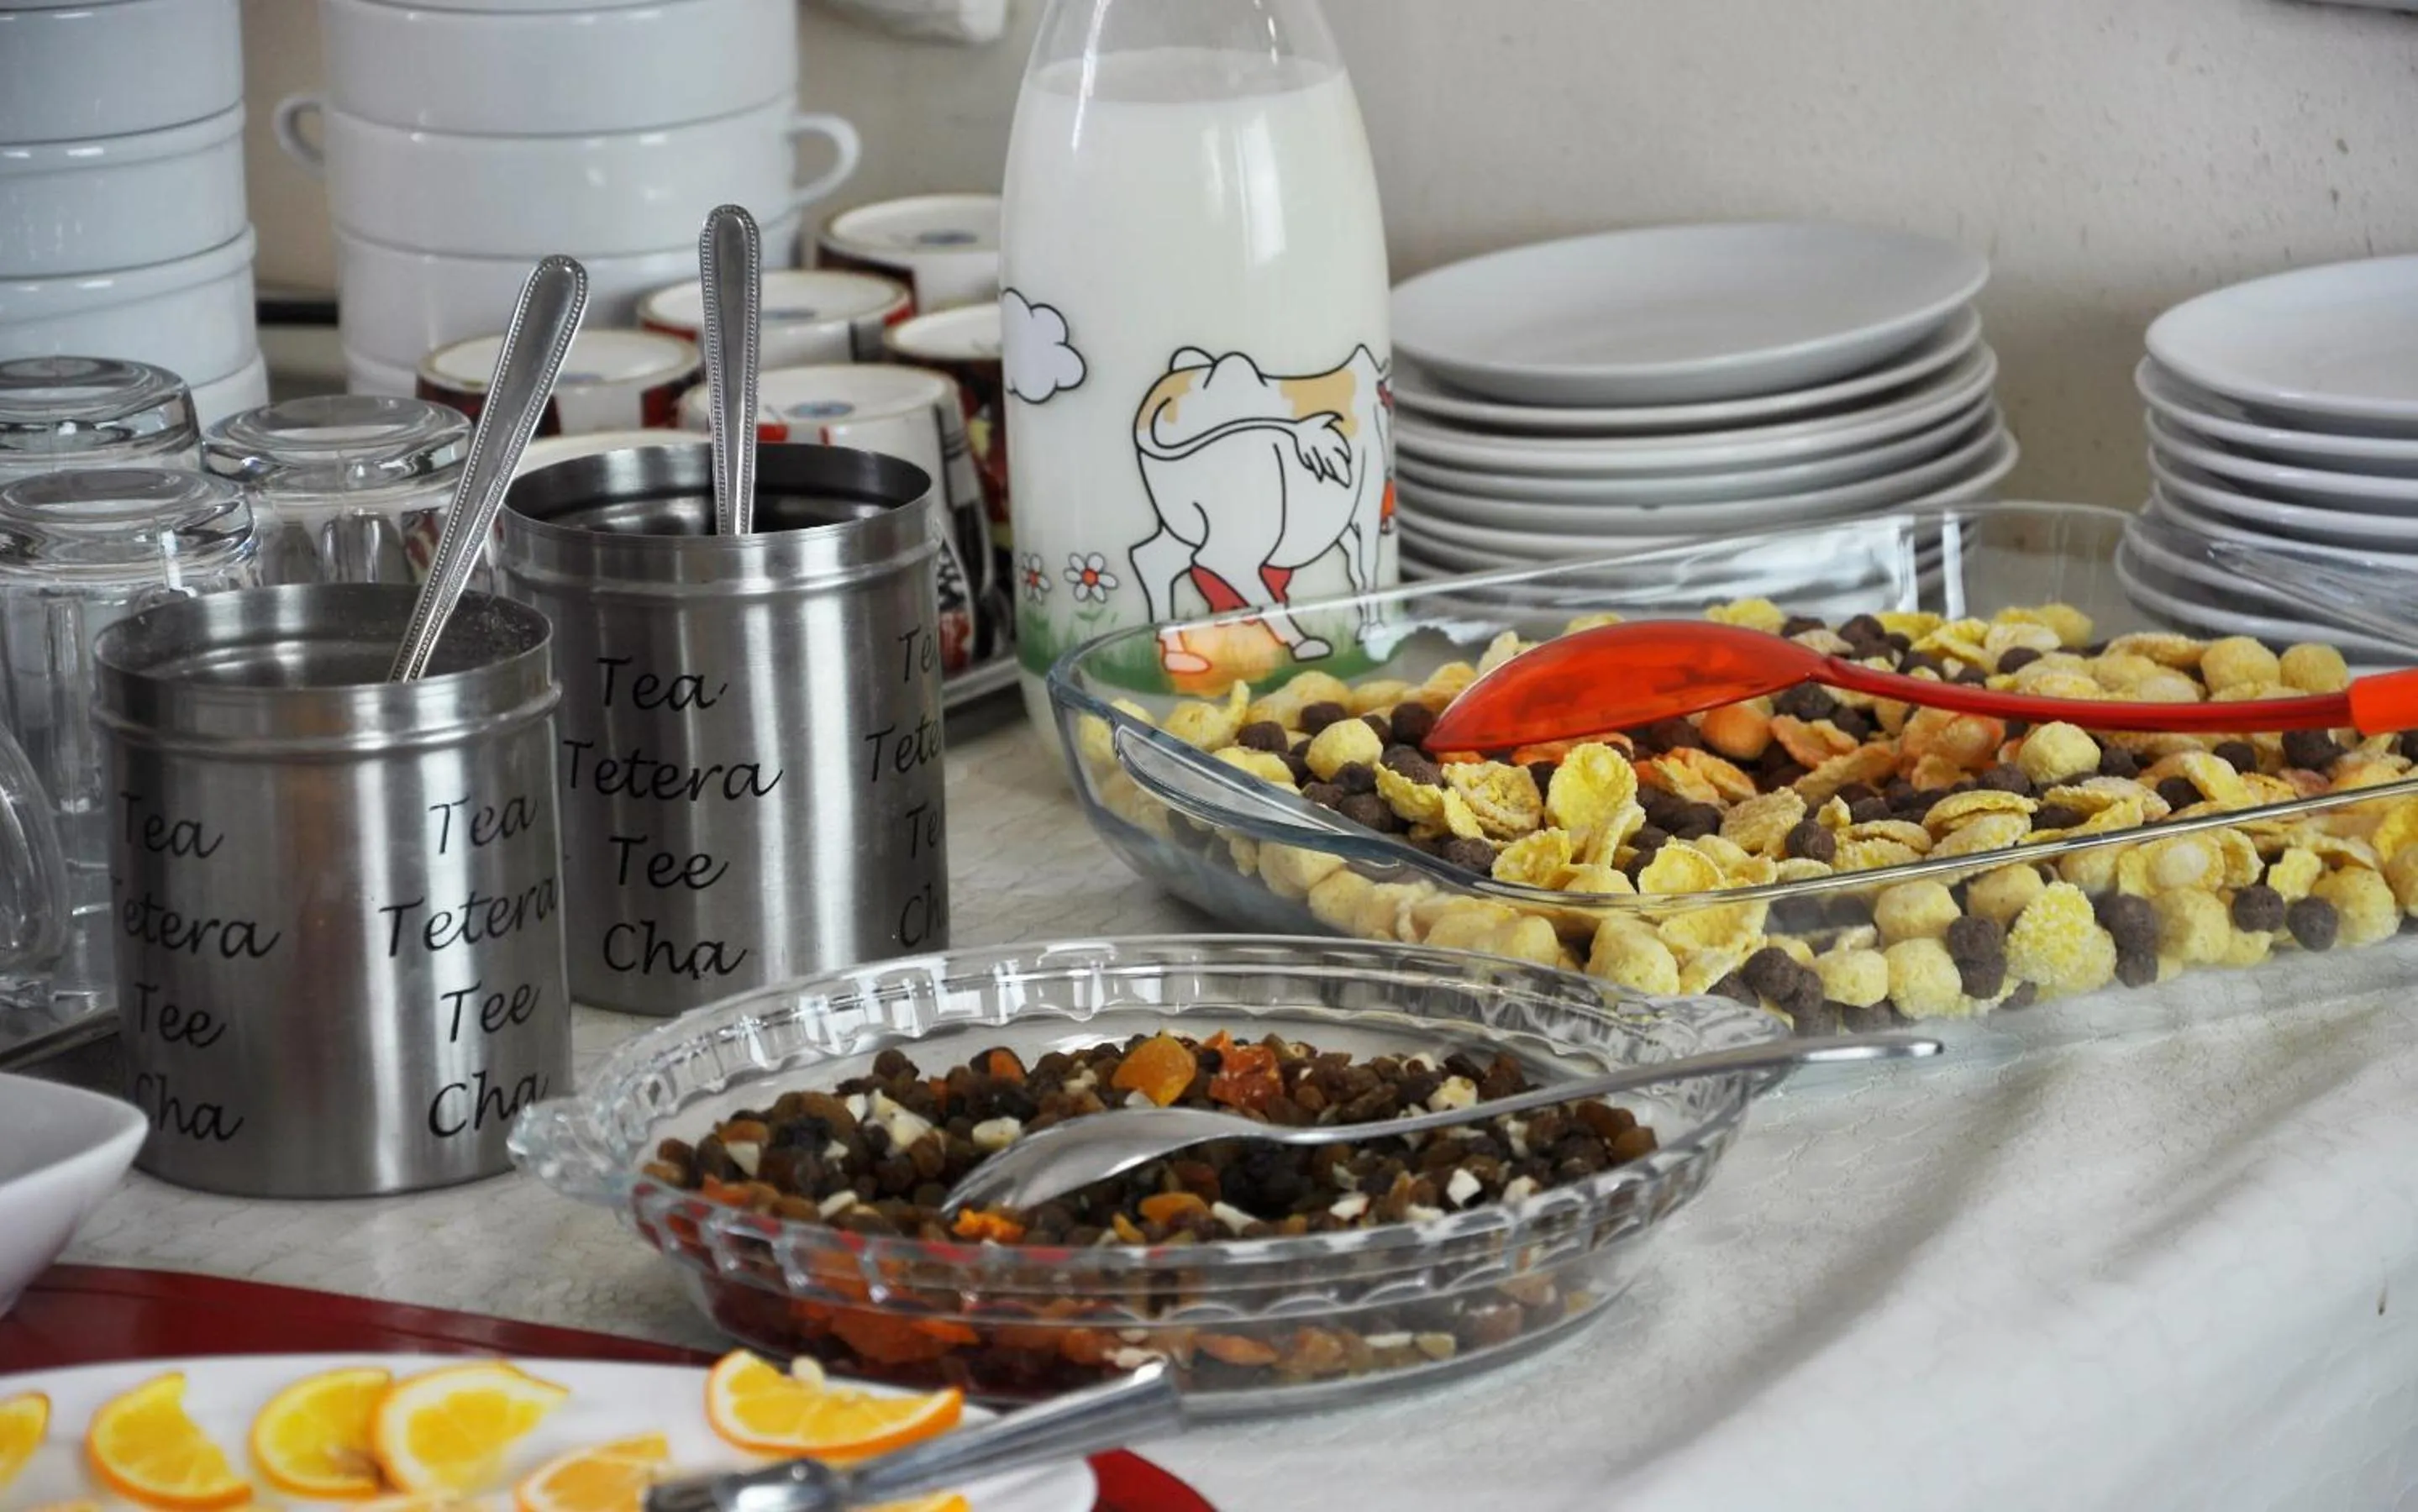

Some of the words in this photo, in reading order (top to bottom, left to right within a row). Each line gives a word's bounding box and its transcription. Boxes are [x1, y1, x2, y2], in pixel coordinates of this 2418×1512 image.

[597, 656, 728, 711] Tea
[898, 624, 937, 682] Te
[563, 739, 784, 801] Tetera
[865, 714, 941, 783] Tete
[119, 790, 224, 859] Tea
[428, 795, 539, 855] Tea
[610, 834, 730, 890] Tee
[111, 874, 281, 959] etera
[379, 875, 557, 958] Tetera
[602, 919, 747, 980] Cha
[134, 981, 226, 1049] Tee
[440, 981, 541, 1043] Tee
[134, 1072, 244, 1142] Cha
[428, 1070, 549, 1139] Cha
